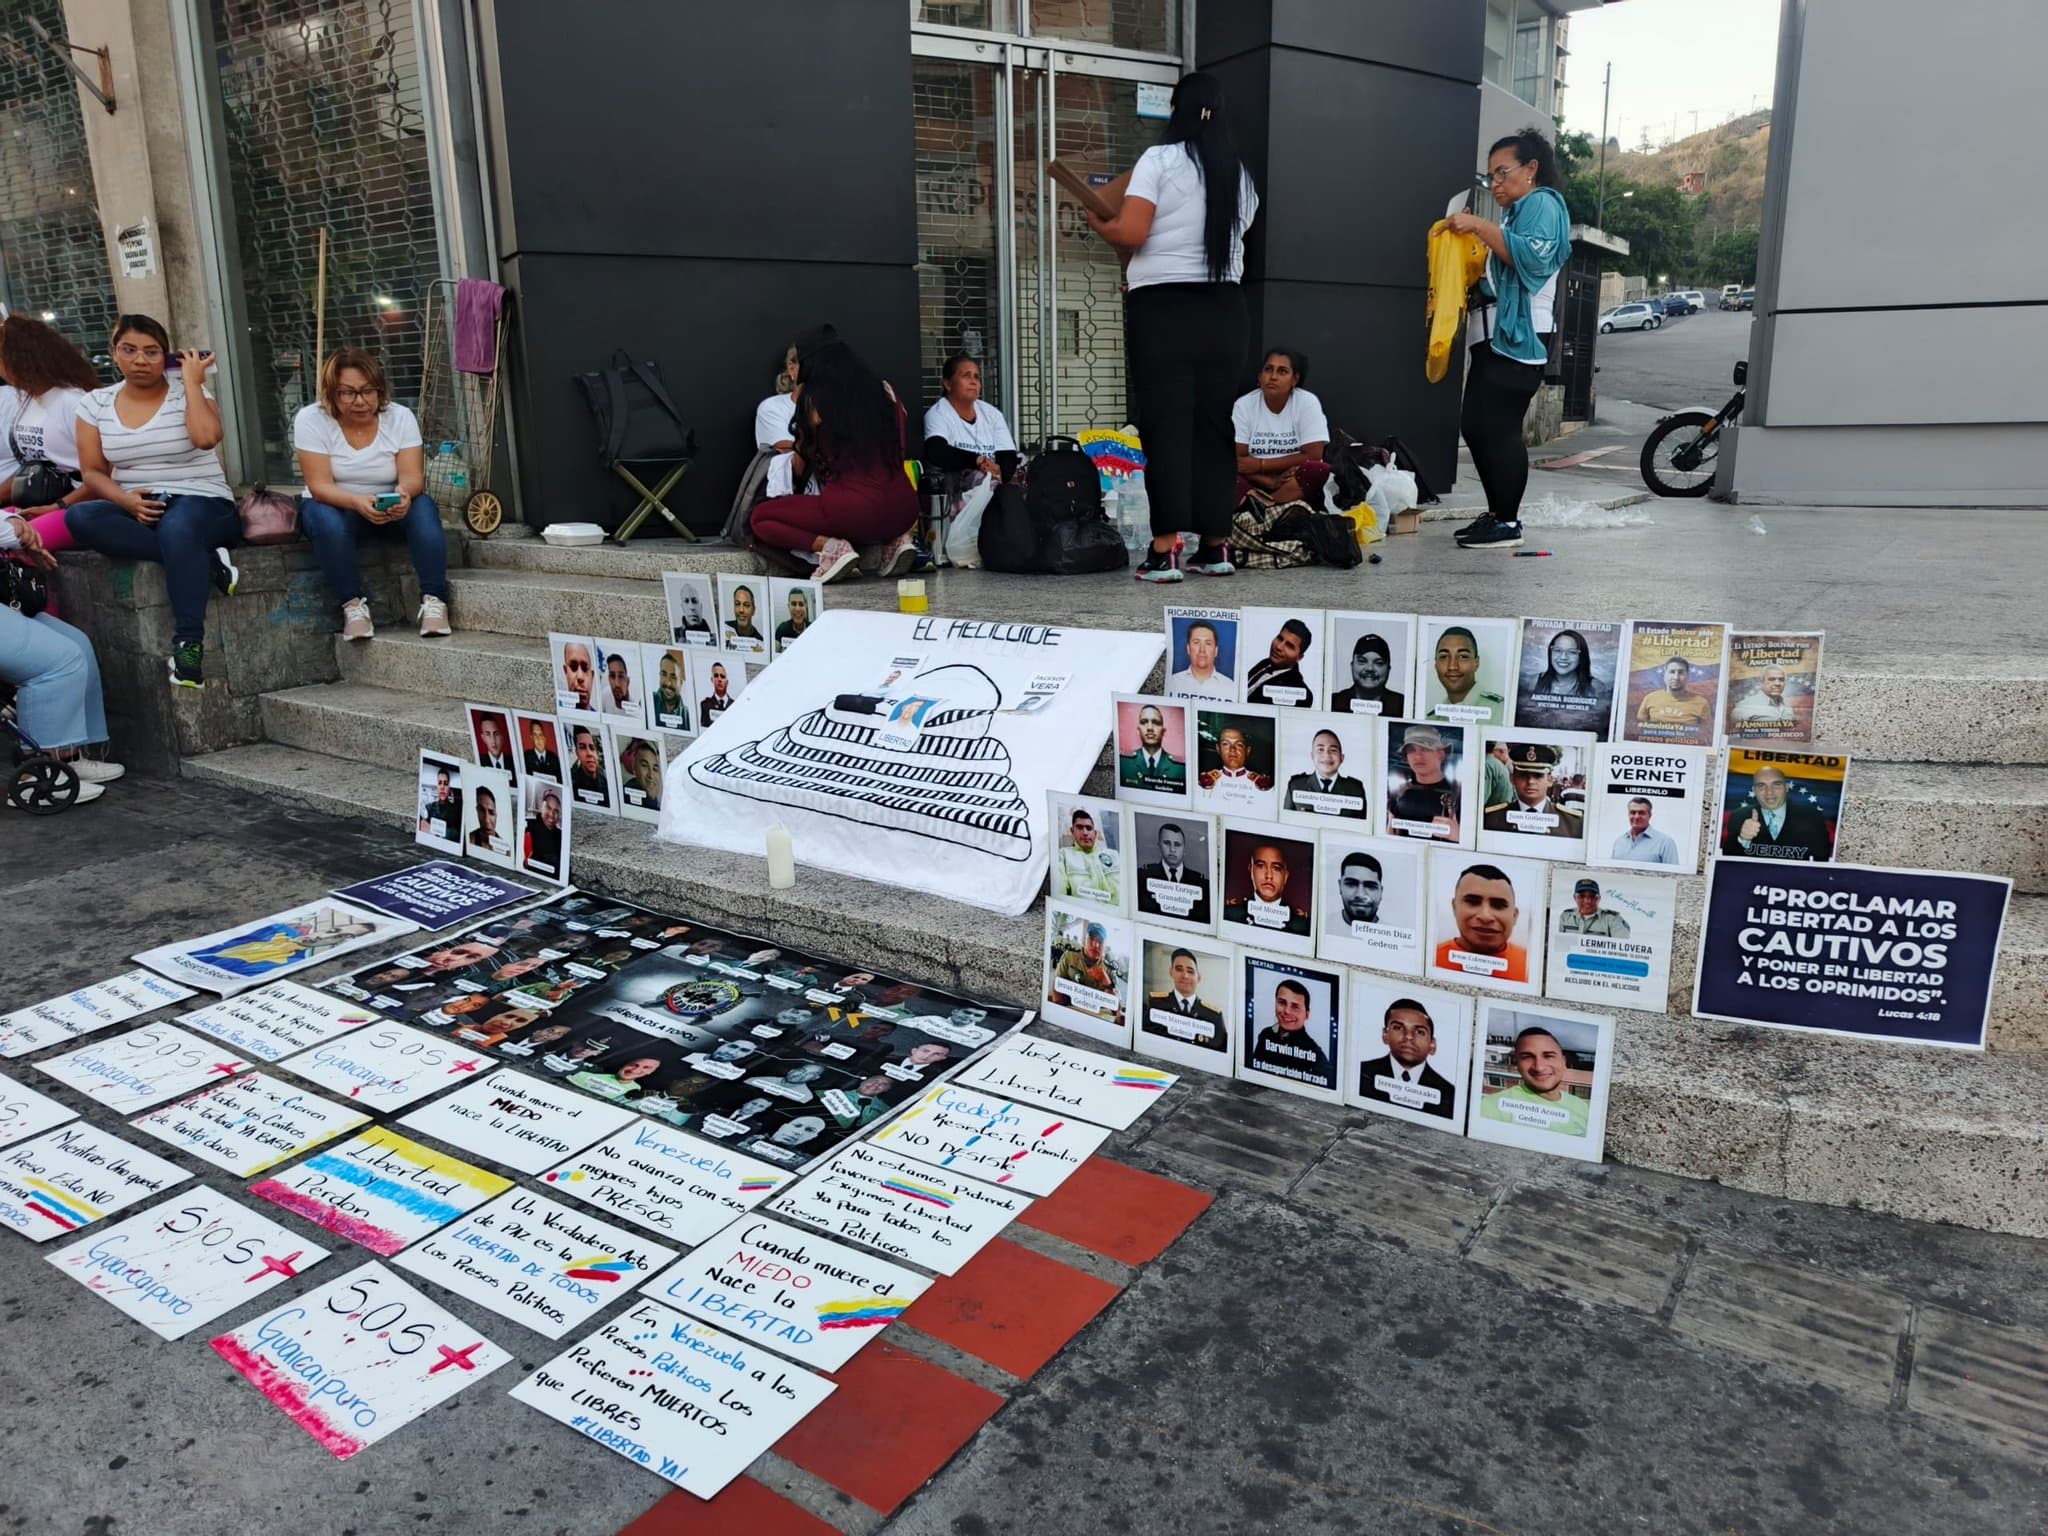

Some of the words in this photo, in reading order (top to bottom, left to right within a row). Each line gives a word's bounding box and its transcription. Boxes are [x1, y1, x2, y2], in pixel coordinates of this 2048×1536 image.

[1268, 438, 1298, 446] PRESOS
[912, 617, 938, 641] EL
[1167, 608, 1208, 619] RICARDO
[1531, 620, 1563, 630] PRIVADA
[1576, 622, 1612, 632] LIBERTAD
[1642, 635, 1710, 648] #Libertad
[1741, 648, 1800, 659] #Libertad
[1031, 681, 1060, 690] VERA
[1610, 755, 1687, 769] ROBERTO
[1743, 750, 1840, 768] LIBERTAD
[1610, 768, 1686, 784] VERNET
[1744, 843, 1809, 859] JERRY
[394, 875, 479, 907] CAUTIVOS
[1354, 923, 1391, 938] Jefferson
[1747, 907, 1873, 933] LIBERTAD
[1878, 920, 1899, 936] A
[1906, 921, 1957, 940] LOS
[1367, 938, 1399, 951] Gedeon
[1580, 938, 1617, 950] LERMITH
[1619, 943, 1653, 955] LOVERA
[1737, 927, 1948, 969] CAUTIVOS
[1736, 970, 1753, 986] A
[1758, 973, 1801, 991] LOS
[1741, 955, 1754, 968] Y
[1757, 958, 1820, 976] PONER
[1824, 963, 1848, 977] EN
[1852, 966, 1944, 987] LIBERTAD
[1878, 1008, 1914, 1020] Lucas
[1916, 1011, 1941, 1022] 4:18
[665, 1027, 700, 1042] TODOS
[1265, 1039, 1293, 1058] Darwin
[980, 1067, 1085, 1107] Libertad
[1302, 1069, 1328, 1086] forzada
[485, 1074, 528, 1100] Cuando
[528, 1096, 564, 1113] muere
[567, 1110, 583, 1118] el
[489, 1097, 543, 1122] MIEDO
[1541, 1106, 1566, 1118] Acosta
[1518, 1114, 1547, 1126] Gedeon
[505, 1122, 570, 1153] LIBERTAD
[633, 1125, 733, 1180] Venezuela
[899, 1129, 930, 1146] NO
[5, 1150, 46, 1175] Preso
[83, 1189, 115, 1205] NO
[346, 1138, 461, 1197] Libertad
[597, 1144, 621, 1160] No
[628, 1158, 685, 1187] avanza
[688, 1184, 717, 1201] con
[720, 1195, 748, 1213] sus
[851, 1148, 874, 1163] No
[878, 1160, 947, 1188] estamos
[579, 1162, 638, 1189] mejores
[645, 1185, 684, 1210] hijos
[774, 1197, 830, 1227] Presos
[821, 1175, 896, 1208] Exigimos
[903, 1201, 973, 1234] Libertad
[472, 1214, 496, 1229] de
[500, 1222, 532, 1242] PAZ
[532, 1239, 555, 1254] es
[558, 1247, 574, 1263] la
[511, 1196, 535, 1217] Un
[542, 1212, 618, 1255] Verdadero
[618, 1249, 650, 1272] Acto
[883, 1210, 922, 1235] todos
[931, 1231, 953, 1247] los
[421, 1242, 448, 1262] Los
[452, 1254, 500, 1289] Presos
[452, 1227, 521, 1265] LIBERTAD
[521, 1262, 547, 1279] DE
[548, 1273, 601, 1305] TODOS
[726, 1250, 813, 1290] MIEDO
[740, 1223, 812, 1266] Cuando
[813, 1260, 871, 1291] muere
[872, 1282, 896, 1297] el
[704, 1266, 757, 1296] Nace
[772, 1288, 798, 1310] la
[666, 1277, 814, 1346] LIBERTAD
[250, 1306, 378, 1429] Guaicaipuro
[629, 1304, 658, 1329] En
[670, 1321, 748, 1373] Venezuela
[750, 1368, 764, 1383] a
[769, 1374, 798, 1401] los
[599, 1324, 649, 1360] Presos
[718, 1388, 753, 1417] Los
[536, 1371, 566, 1392] que
[571, 1388, 642, 1432] LIBRES
[567, 1345, 636, 1392] Prefieren
[640, 1383, 729, 1437] MUERTOS
[570, 1414, 652, 1465] #LIBERTAD
[657, 1456, 689, 1483] YA!
